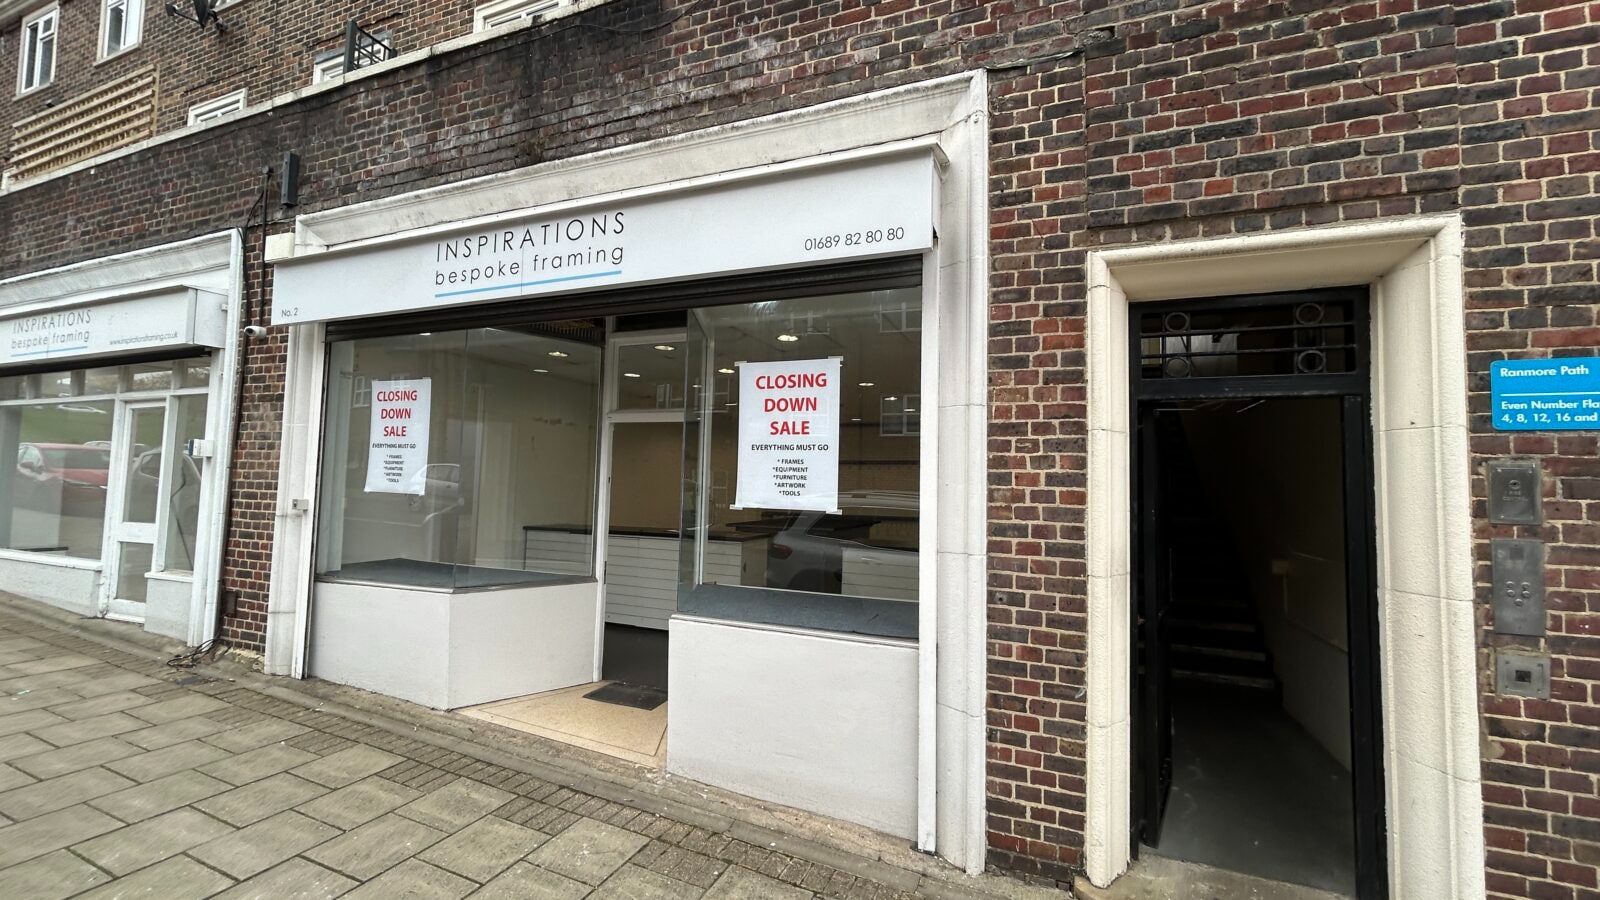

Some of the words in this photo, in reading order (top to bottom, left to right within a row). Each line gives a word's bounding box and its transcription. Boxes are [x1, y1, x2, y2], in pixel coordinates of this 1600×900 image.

[436, 212, 625, 262] INSPIRATIONS
[804, 234, 841, 251] 01689
[844, 232, 861, 246] 82
[865, 229, 883, 244] 80
[886, 226, 905, 241] 80
[435, 260, 521, 286] bespoke
[533, 246, 624, 272] framing
[281, 309, 292, 317] No.
[293, 307, 298, 316] 2
[12, 309, 92, 334] INSPIRATIONS
[11, 336, 49, 350] bespoke
[52, 329, 90, 343] framing
[1500, 367, 1557, 377] Ranmore
[1560, 364, 1590, 376] Path
[755, 373, 828, 389] CLOSING
[377, 390, 417, 401] CLOSING
[764, 397, 818, 412] DOWN
[1501, 401, 1528, 410] Even
[1531, 400, 1579, 410] Number
[1582, 398, 1600, 409] Fla
[381, 408, 411, 419] DOWN
[1501, 413, 1513, 423] 4,
[1516, 413, 1528, 423] 8,
[1533, 413, 1551, 423] 12,
[1556, 413, 1571, 422] 16
[1574, 411, 1598, 422] and
[383, 426, 407, 437] SALE
[770, 421, 811, 435] SALE
